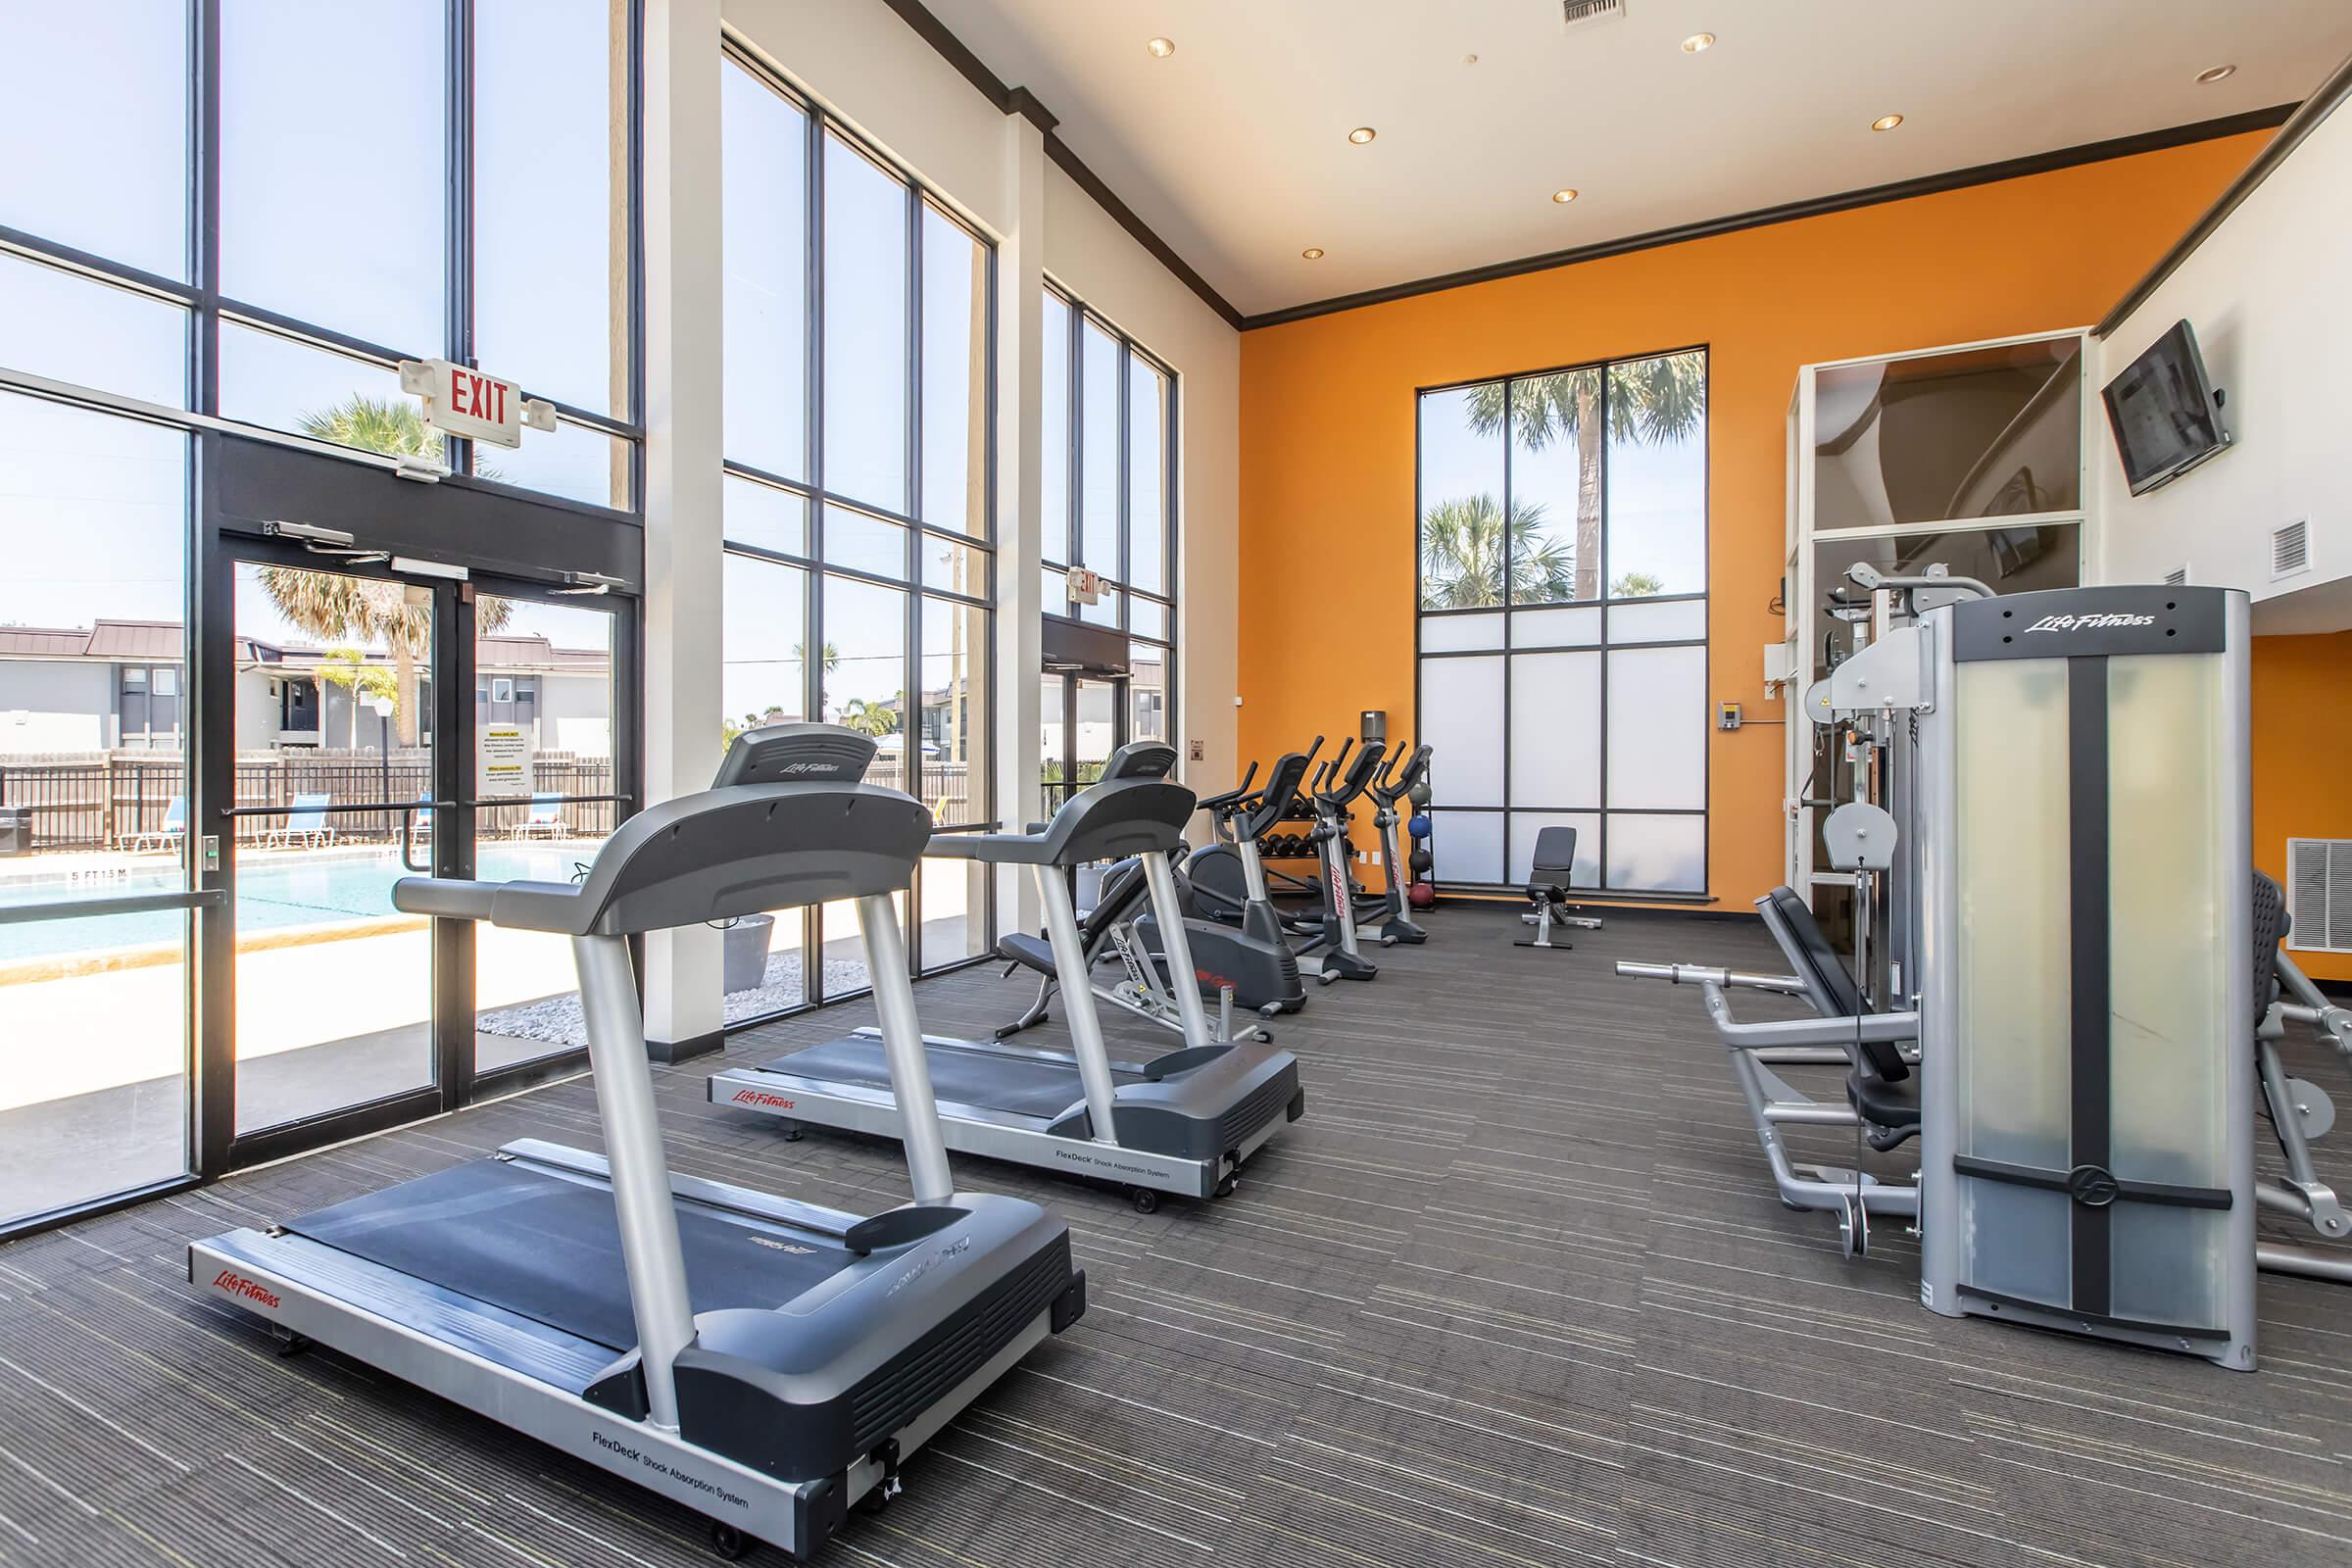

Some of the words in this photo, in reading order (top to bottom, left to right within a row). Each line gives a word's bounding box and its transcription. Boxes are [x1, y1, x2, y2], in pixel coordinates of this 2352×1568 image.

[451, 368, 508, 424] EXIT
[72, 871, 78, 881] 5
[118, 868, 126, 878] M
[1055, 1150, 1092, 1163] FlexDeck
[1094, 1158, 1112, 1167] Shock
[1113, 1163, 1147, 1174] Absorption
[1147, 1168, 1171, 1179] System
[592, 1431, 640, 1462] FlexDeck
[643, 1455, 668, 1475] Shock
[669, 1468, 715, 1494] Absorption
[716, 1487, 750, 1509] System
